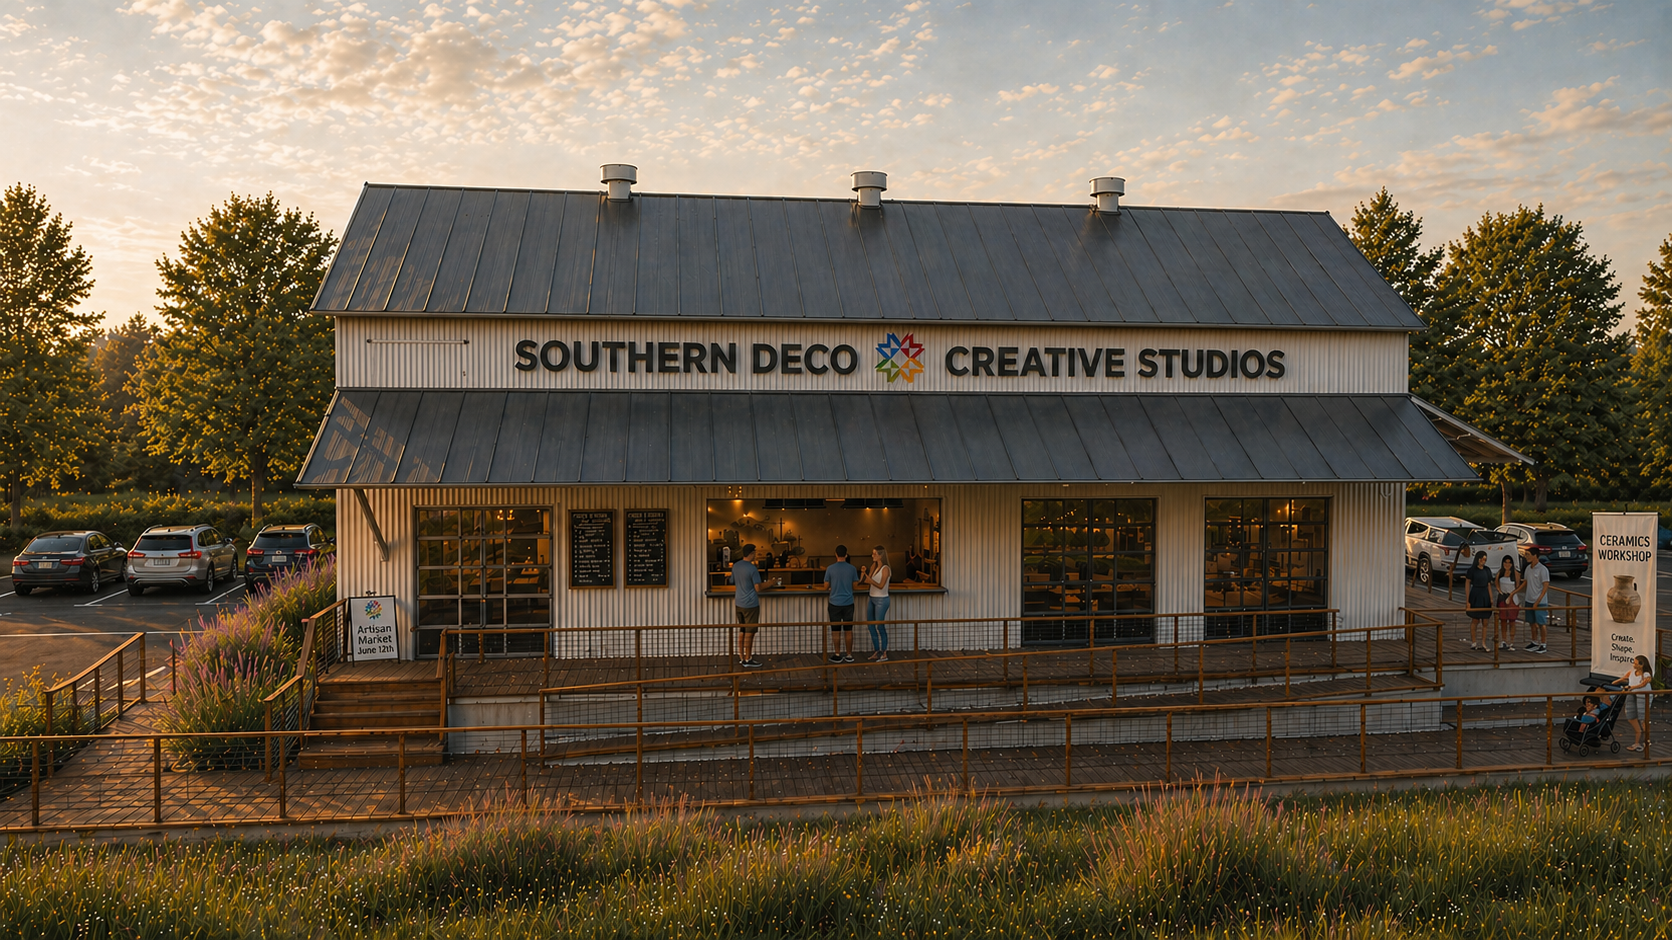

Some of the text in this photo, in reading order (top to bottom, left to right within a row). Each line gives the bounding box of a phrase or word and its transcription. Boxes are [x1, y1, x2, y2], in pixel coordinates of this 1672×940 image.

[514, 339, 1286, 379] SOUTHERN DECO CREATIVE STUDIOS
[1599, 535, 1650, 547] CERAMICS
[1598, 549, 1652, 562] WORKSHOP
[357, 625, 392, 634] Artisan
[358, 635, 392, 645] Market
[378, 645, 394, 653] 12th
